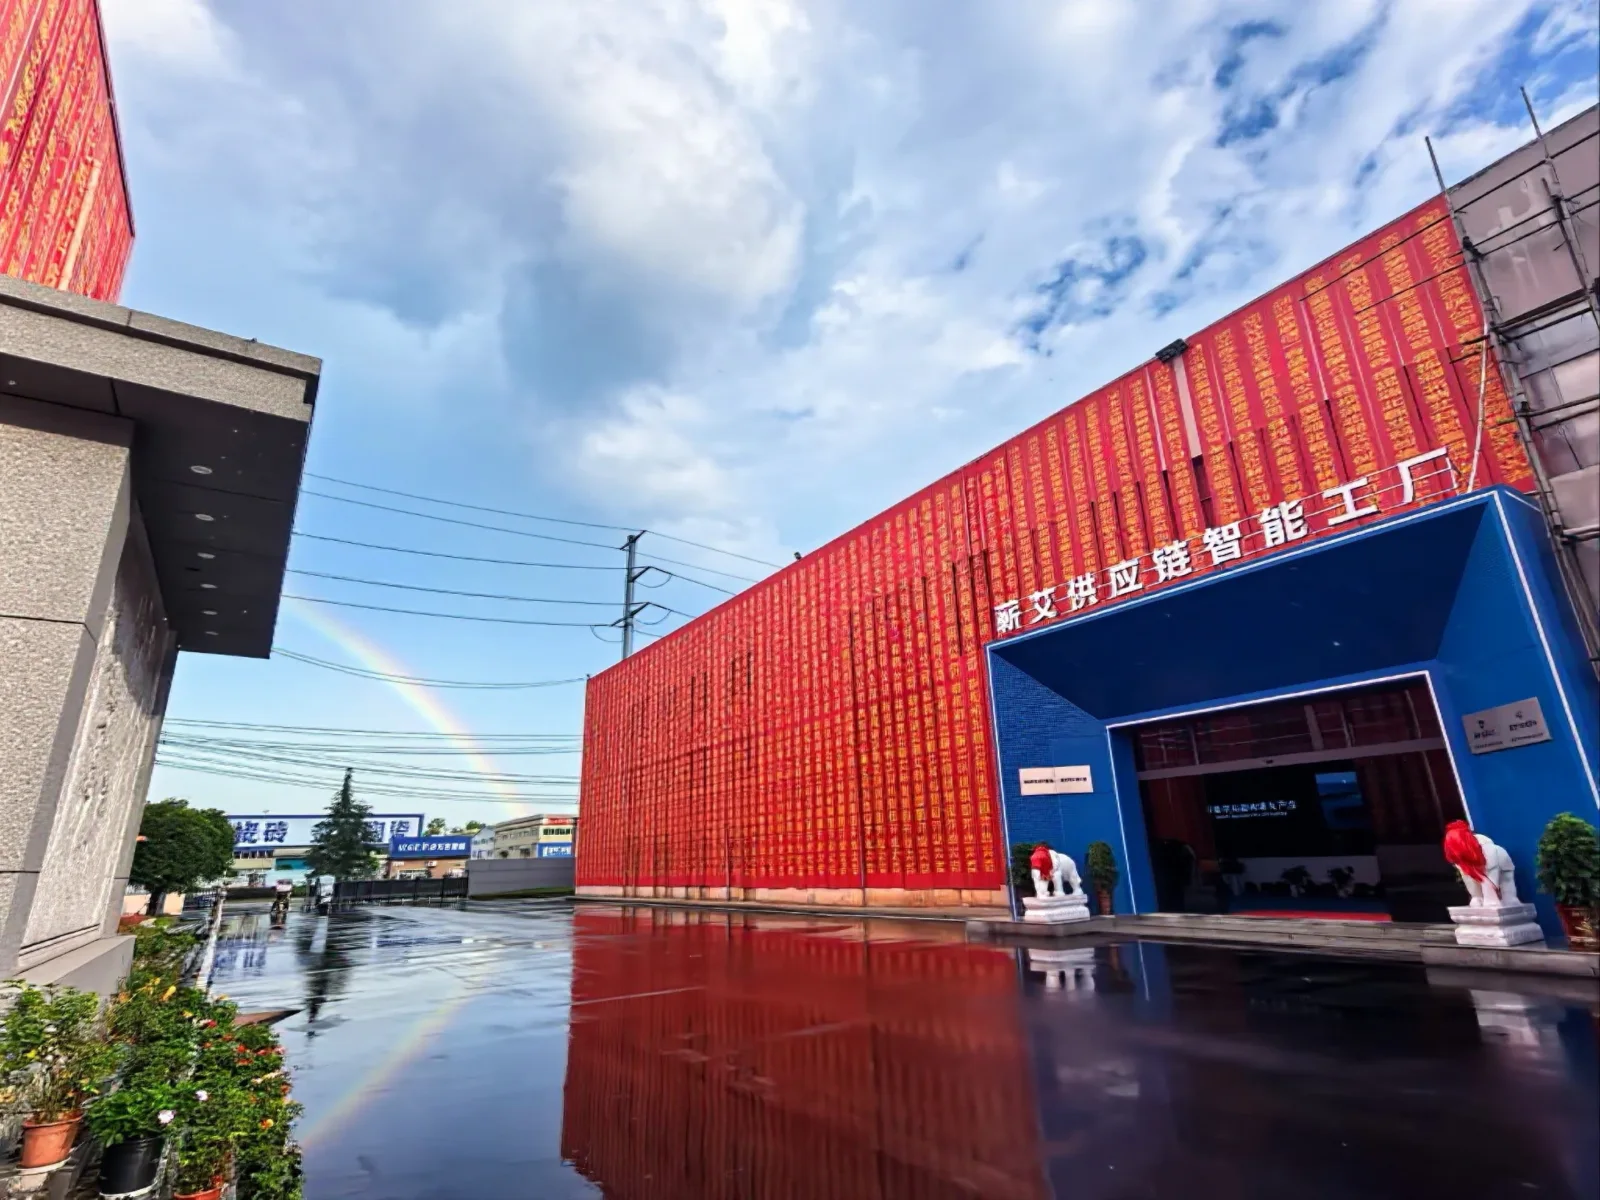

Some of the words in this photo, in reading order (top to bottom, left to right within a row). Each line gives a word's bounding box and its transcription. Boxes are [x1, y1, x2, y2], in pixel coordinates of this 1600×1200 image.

[994, 448, 1449, 633] 蕲艾供应链智能工厂
